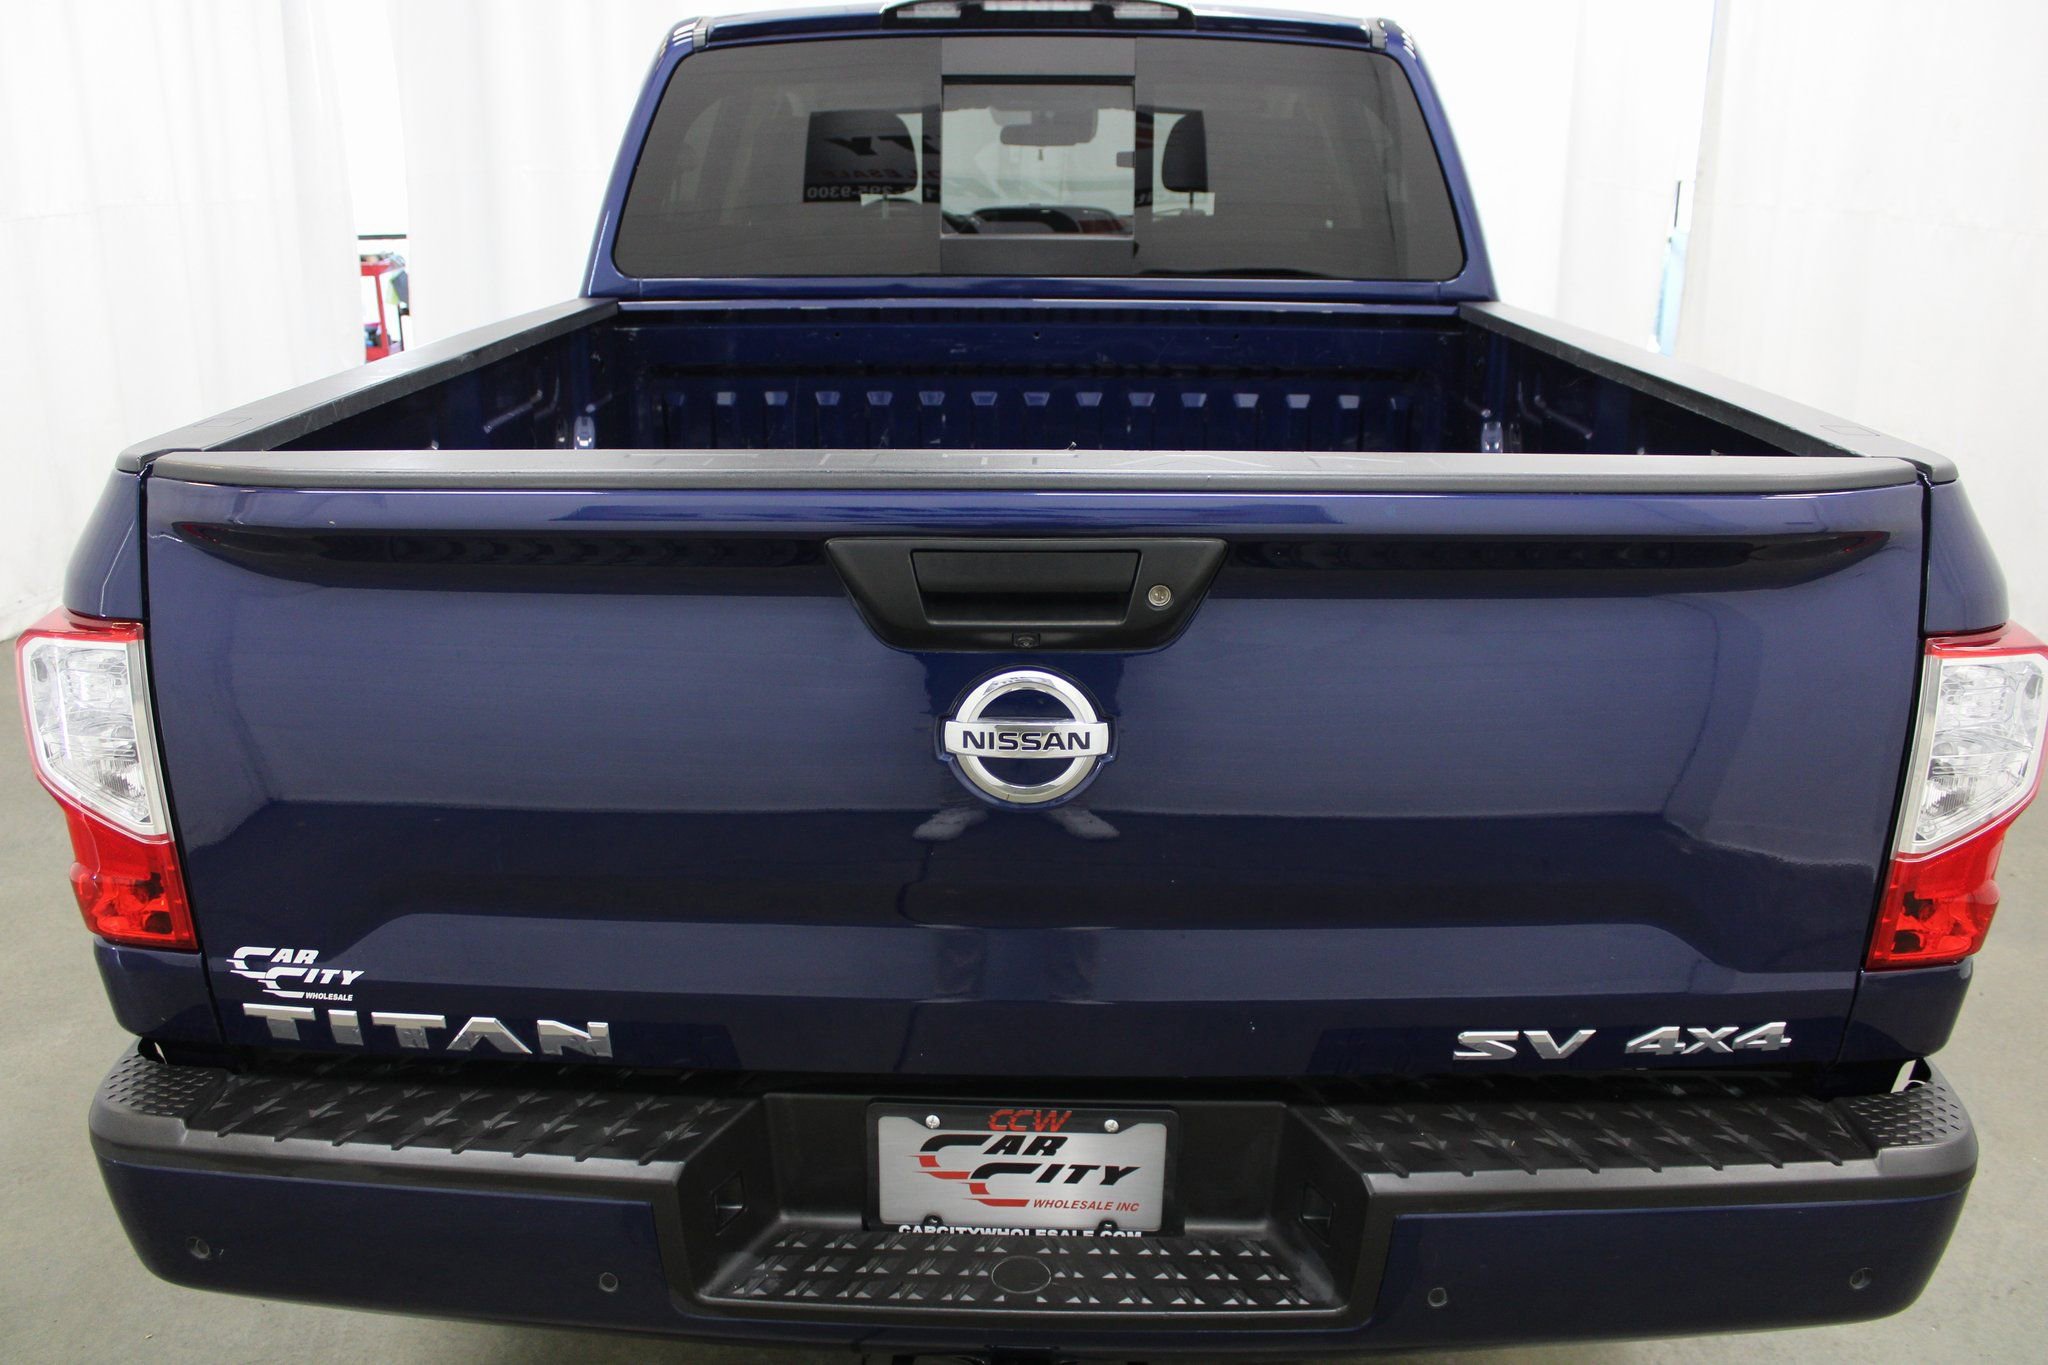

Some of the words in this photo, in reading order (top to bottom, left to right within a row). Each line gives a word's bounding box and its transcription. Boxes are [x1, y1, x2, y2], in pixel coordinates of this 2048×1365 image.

[962, 730, 1091, 751] NISSAN
[226, 945, 320, 978] CAR
[257, 966, 365, 999] CITY
[304, 991, 353, 1002] WHOLESALE
[241, 1002, 613, 1059] TITAN
[1452, 1028, 1597, 1061] SV
[987, 1108, 1073, 1132] CCW
[907, 1133, 1069, 1180] CAR
[960, 1162, 1142, 1208] CITY
[1033, 1198, 1112, 1211] WHOLESALE
[1115, 1200, 1141, 1212] INC
